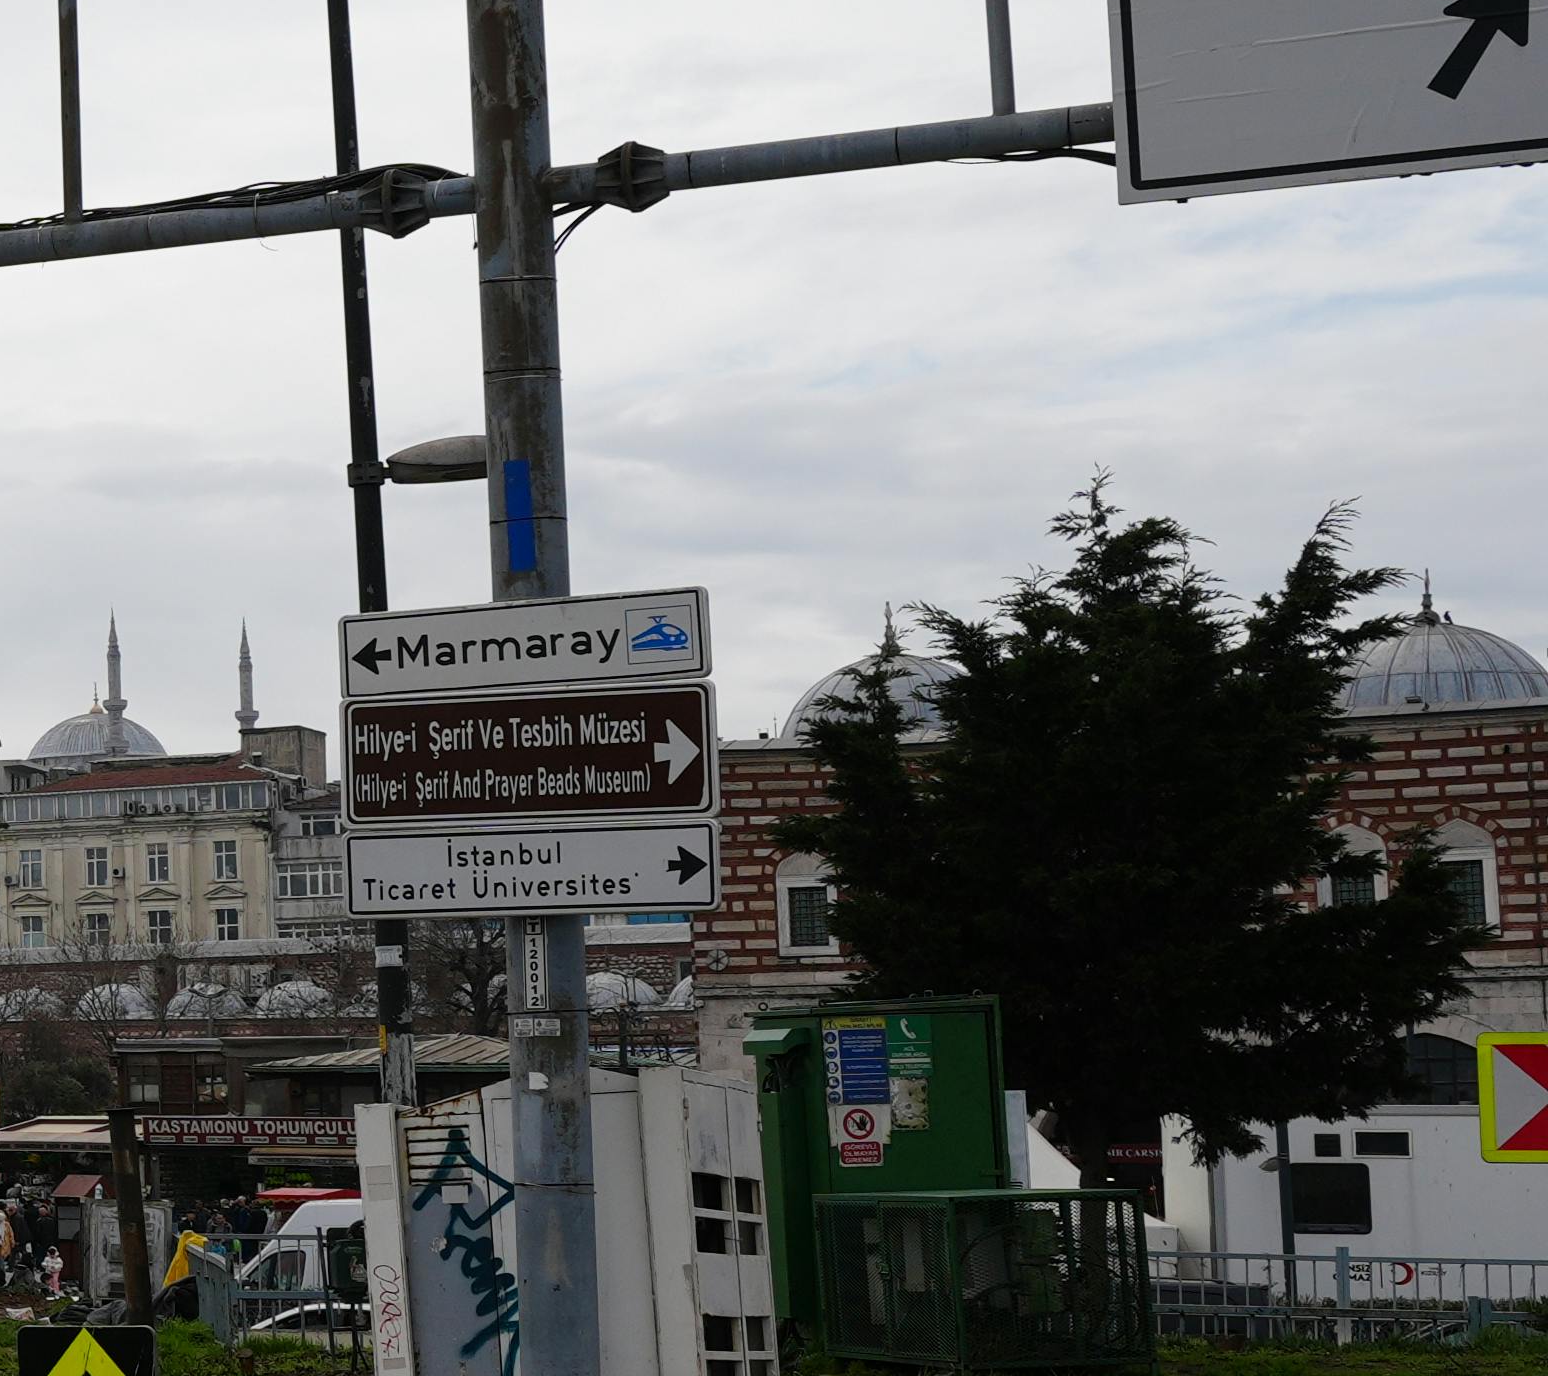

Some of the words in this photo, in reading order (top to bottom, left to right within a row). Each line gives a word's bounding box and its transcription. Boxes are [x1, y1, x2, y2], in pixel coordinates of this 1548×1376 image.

[397, 627, 620, 669] Marmaray
[355, 720, 417, 761] Hilye-i
[429, 718, 473, 759] Şerif
[478, 719, 504, 749] Ve
[509, 715, 573, 748] Tesbih
[579, 711, 646, 744] Müzesi
[355, 774, 407, 808] (Hilye-i
[416, 769, 449, 807] Şerif
[453, 770, 480, 799] And
[485, 767, 533, 803] Prayer
[538, 765, 580, 796] Beads
[585, 762, 651, 794] Museum)
[446, 839, 562, 868] İstanbul
[363, 876, 456, 902] Ticaret
[472, 869, 639, 899] Üniversites
[148, 1119, 249, 1134] KASTAMONU
